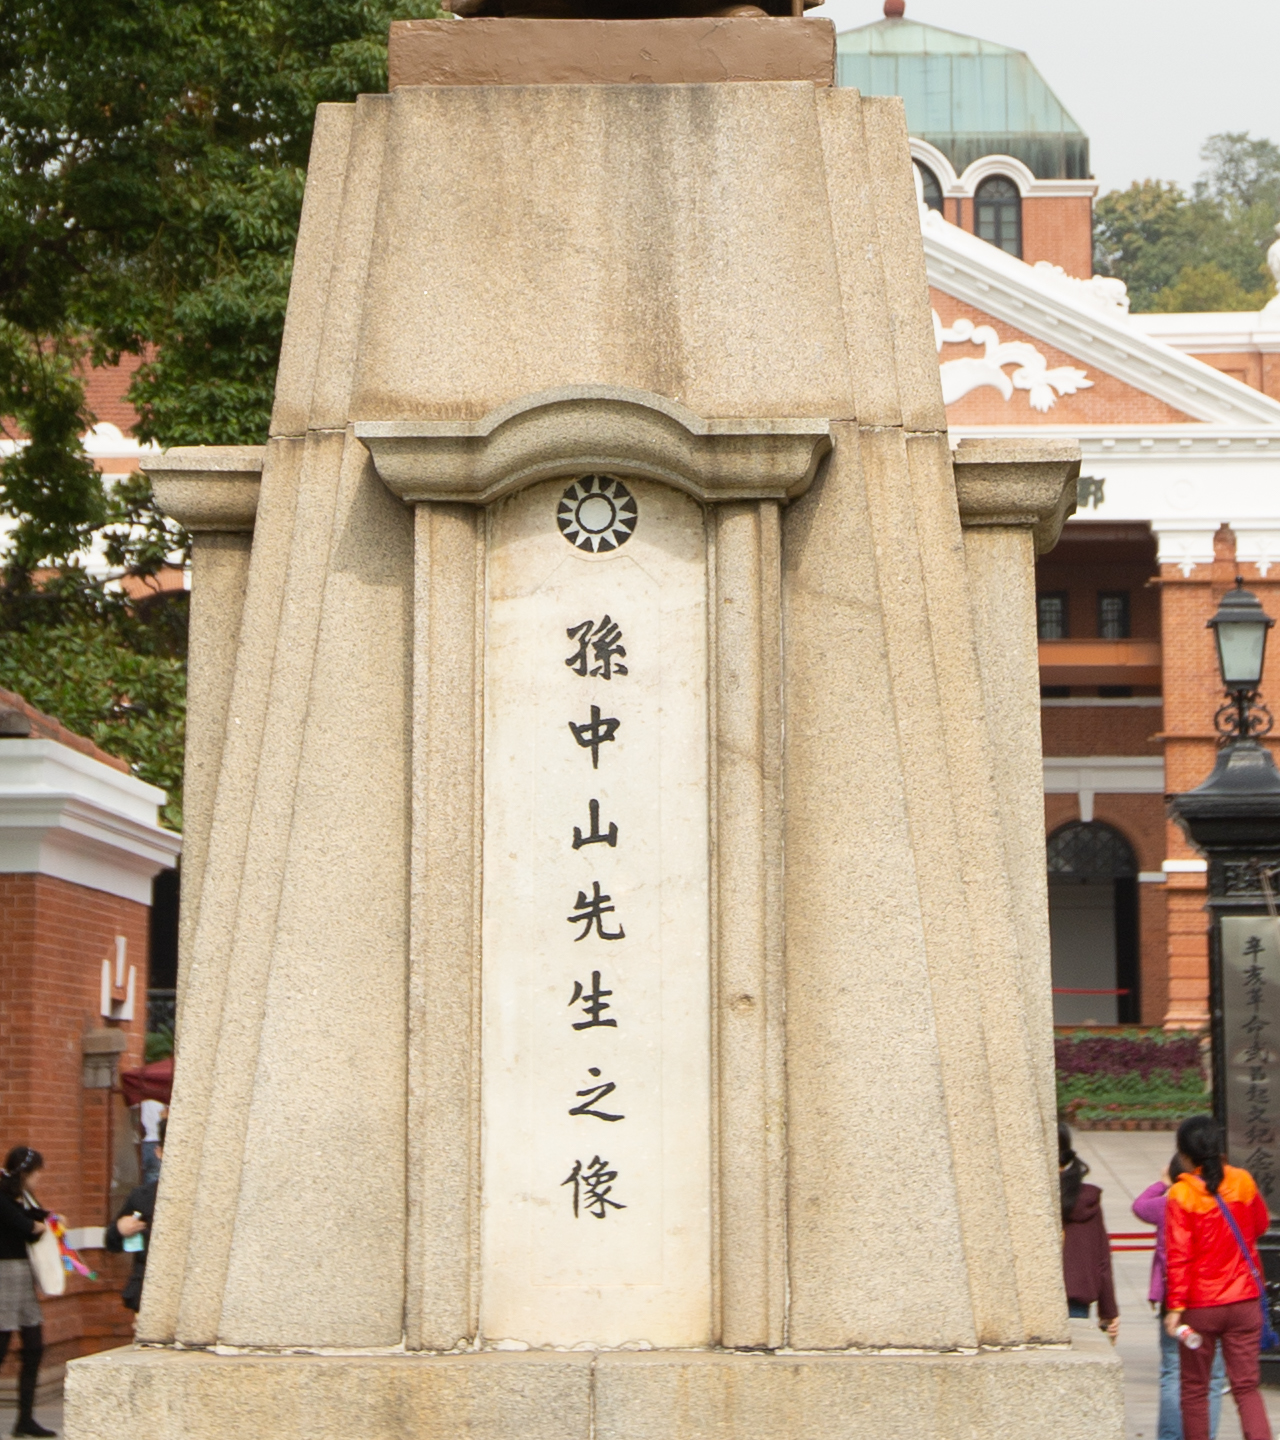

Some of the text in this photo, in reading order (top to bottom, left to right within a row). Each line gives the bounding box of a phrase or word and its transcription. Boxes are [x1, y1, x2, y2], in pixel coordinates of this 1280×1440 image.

[561, 614, 629, 1219] 孫中山先生之像
